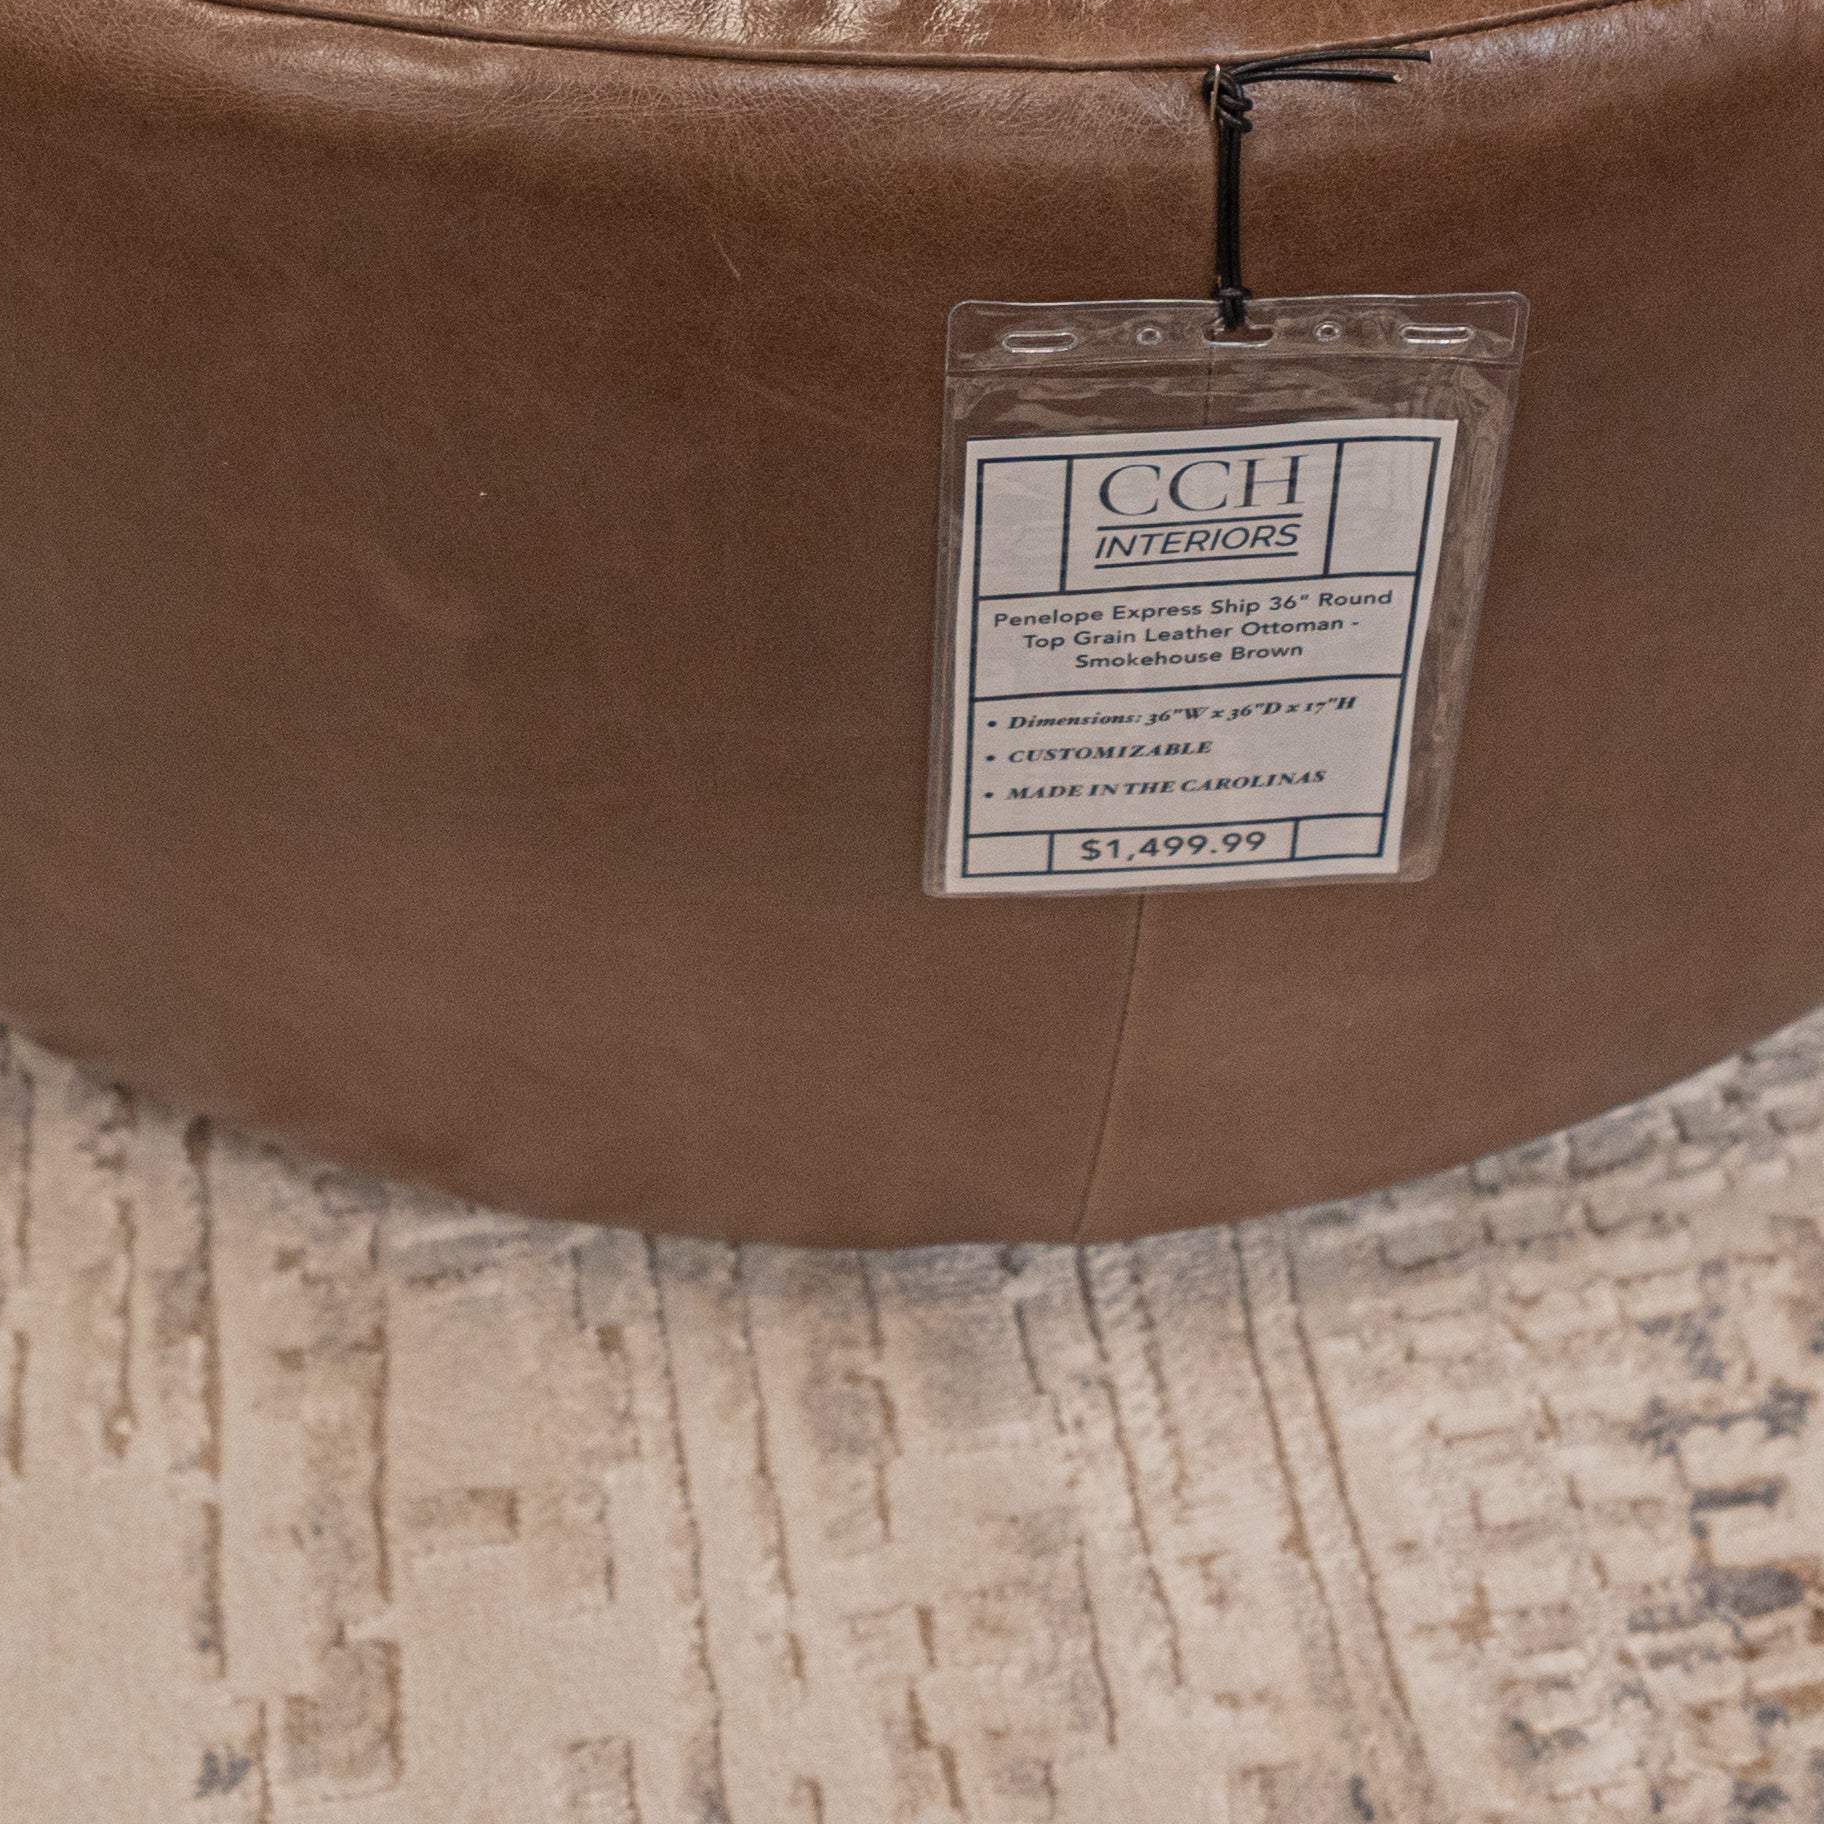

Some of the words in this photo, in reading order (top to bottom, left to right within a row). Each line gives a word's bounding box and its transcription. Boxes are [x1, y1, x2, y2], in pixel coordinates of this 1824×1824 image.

[1098, 454, 1310, 516] CCH
[1095, 522, 1302, 560] INTERIORS
[994, 607, 1103, 629] Penelope
[1112, 601, 1205, 625] Express
[1210, 596, 1260, 618] Ship
[1268, 593, 1311, 612] 36"
[1318, 590, 1393, 608] Round
[1023, 634, 1066, 652] Top
[1073, 628, 1137, 648] Grain
[1145, 623, 1233, 644] Leather
[1241, 618, 1345, 637] Ottoman
[1075, 649, 1223, 669] Smokehouse
[1231, 644, 1304, 662] Brown
[1007, 710, 1142, 730] Dimensions:
[1210, 708, 1225, 719] x
[1285, 703, 1300, 714] x
[1007, 740, 1214, 764] CUSTOMIZABLE
[1004, 782, 1084, 801] MADE
[1088, 781, 1125, 798] IN
[1125, 779, 1177, 796] THE
[1180, 769, 1328, 793] CAROLINAS
[1081, 830, 1267, 862] $1,499.99
